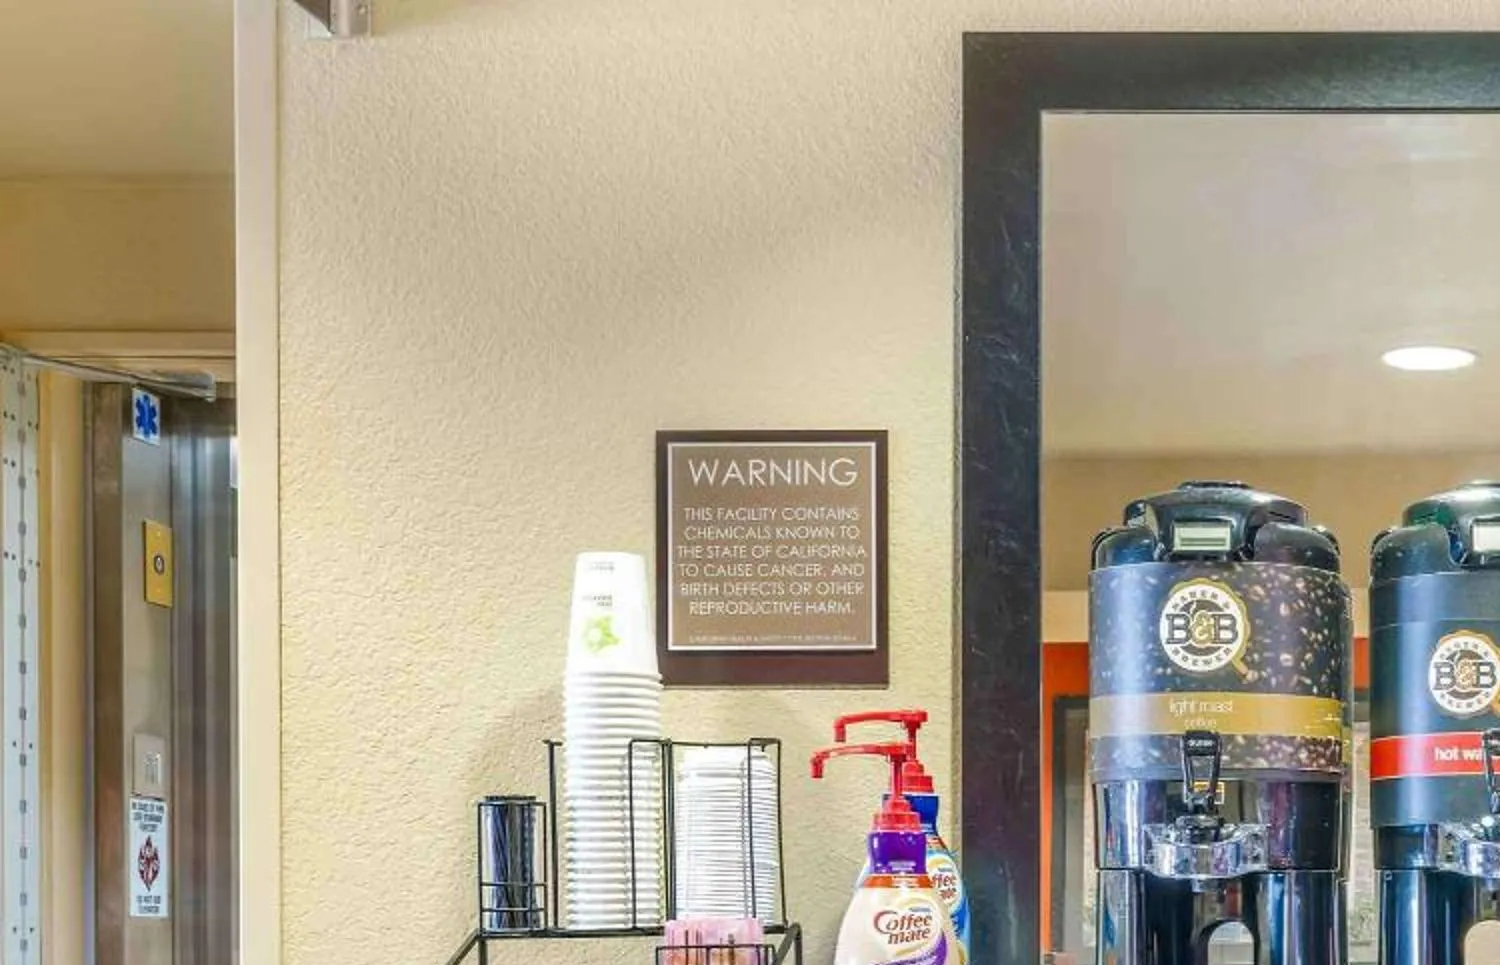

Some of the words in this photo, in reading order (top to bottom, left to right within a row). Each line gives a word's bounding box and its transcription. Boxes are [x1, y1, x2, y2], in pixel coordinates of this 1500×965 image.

[688, 458, 859, 487] WARNING
[684, 507, 713, 521] THIS
[717, 507, 777, 521] FACILITY
[781, 507, 860, 521] CONTAINS
[684, 526, 771, 540] CHEMICALS
[776, 526, 835, 540] KNOWN
[840, 526, 860, 539] TO
[677, 545, 702, 559] THE
[707, 545, 747, 559] STATE
[752, 545, 772, 558] OF
[776, 545, 866, 559] CALIFORNIA
[679, 563, 699, 577] TO
[703, 563, 753, 577] CAUSE
[831, 563, 865, 577] AND
[680, 582, 719, 596] BIRTH
[723, 582, 785, 596] DEFECTS
[789, 582, 811, 596] OR
[815, 582, 864, 596] OTHER
[689, 601, 801, 616] REPRODUCTIVE
[1165, 611, 1239, 647] B&B
[1433, 660, 1496, 691] B&B
[1169, 697, 1196, 717] light
[1434, 747, 1459, 761] hot
[874, 910, 933, 934] Coffee
[887, 927, 931, 945] mate
